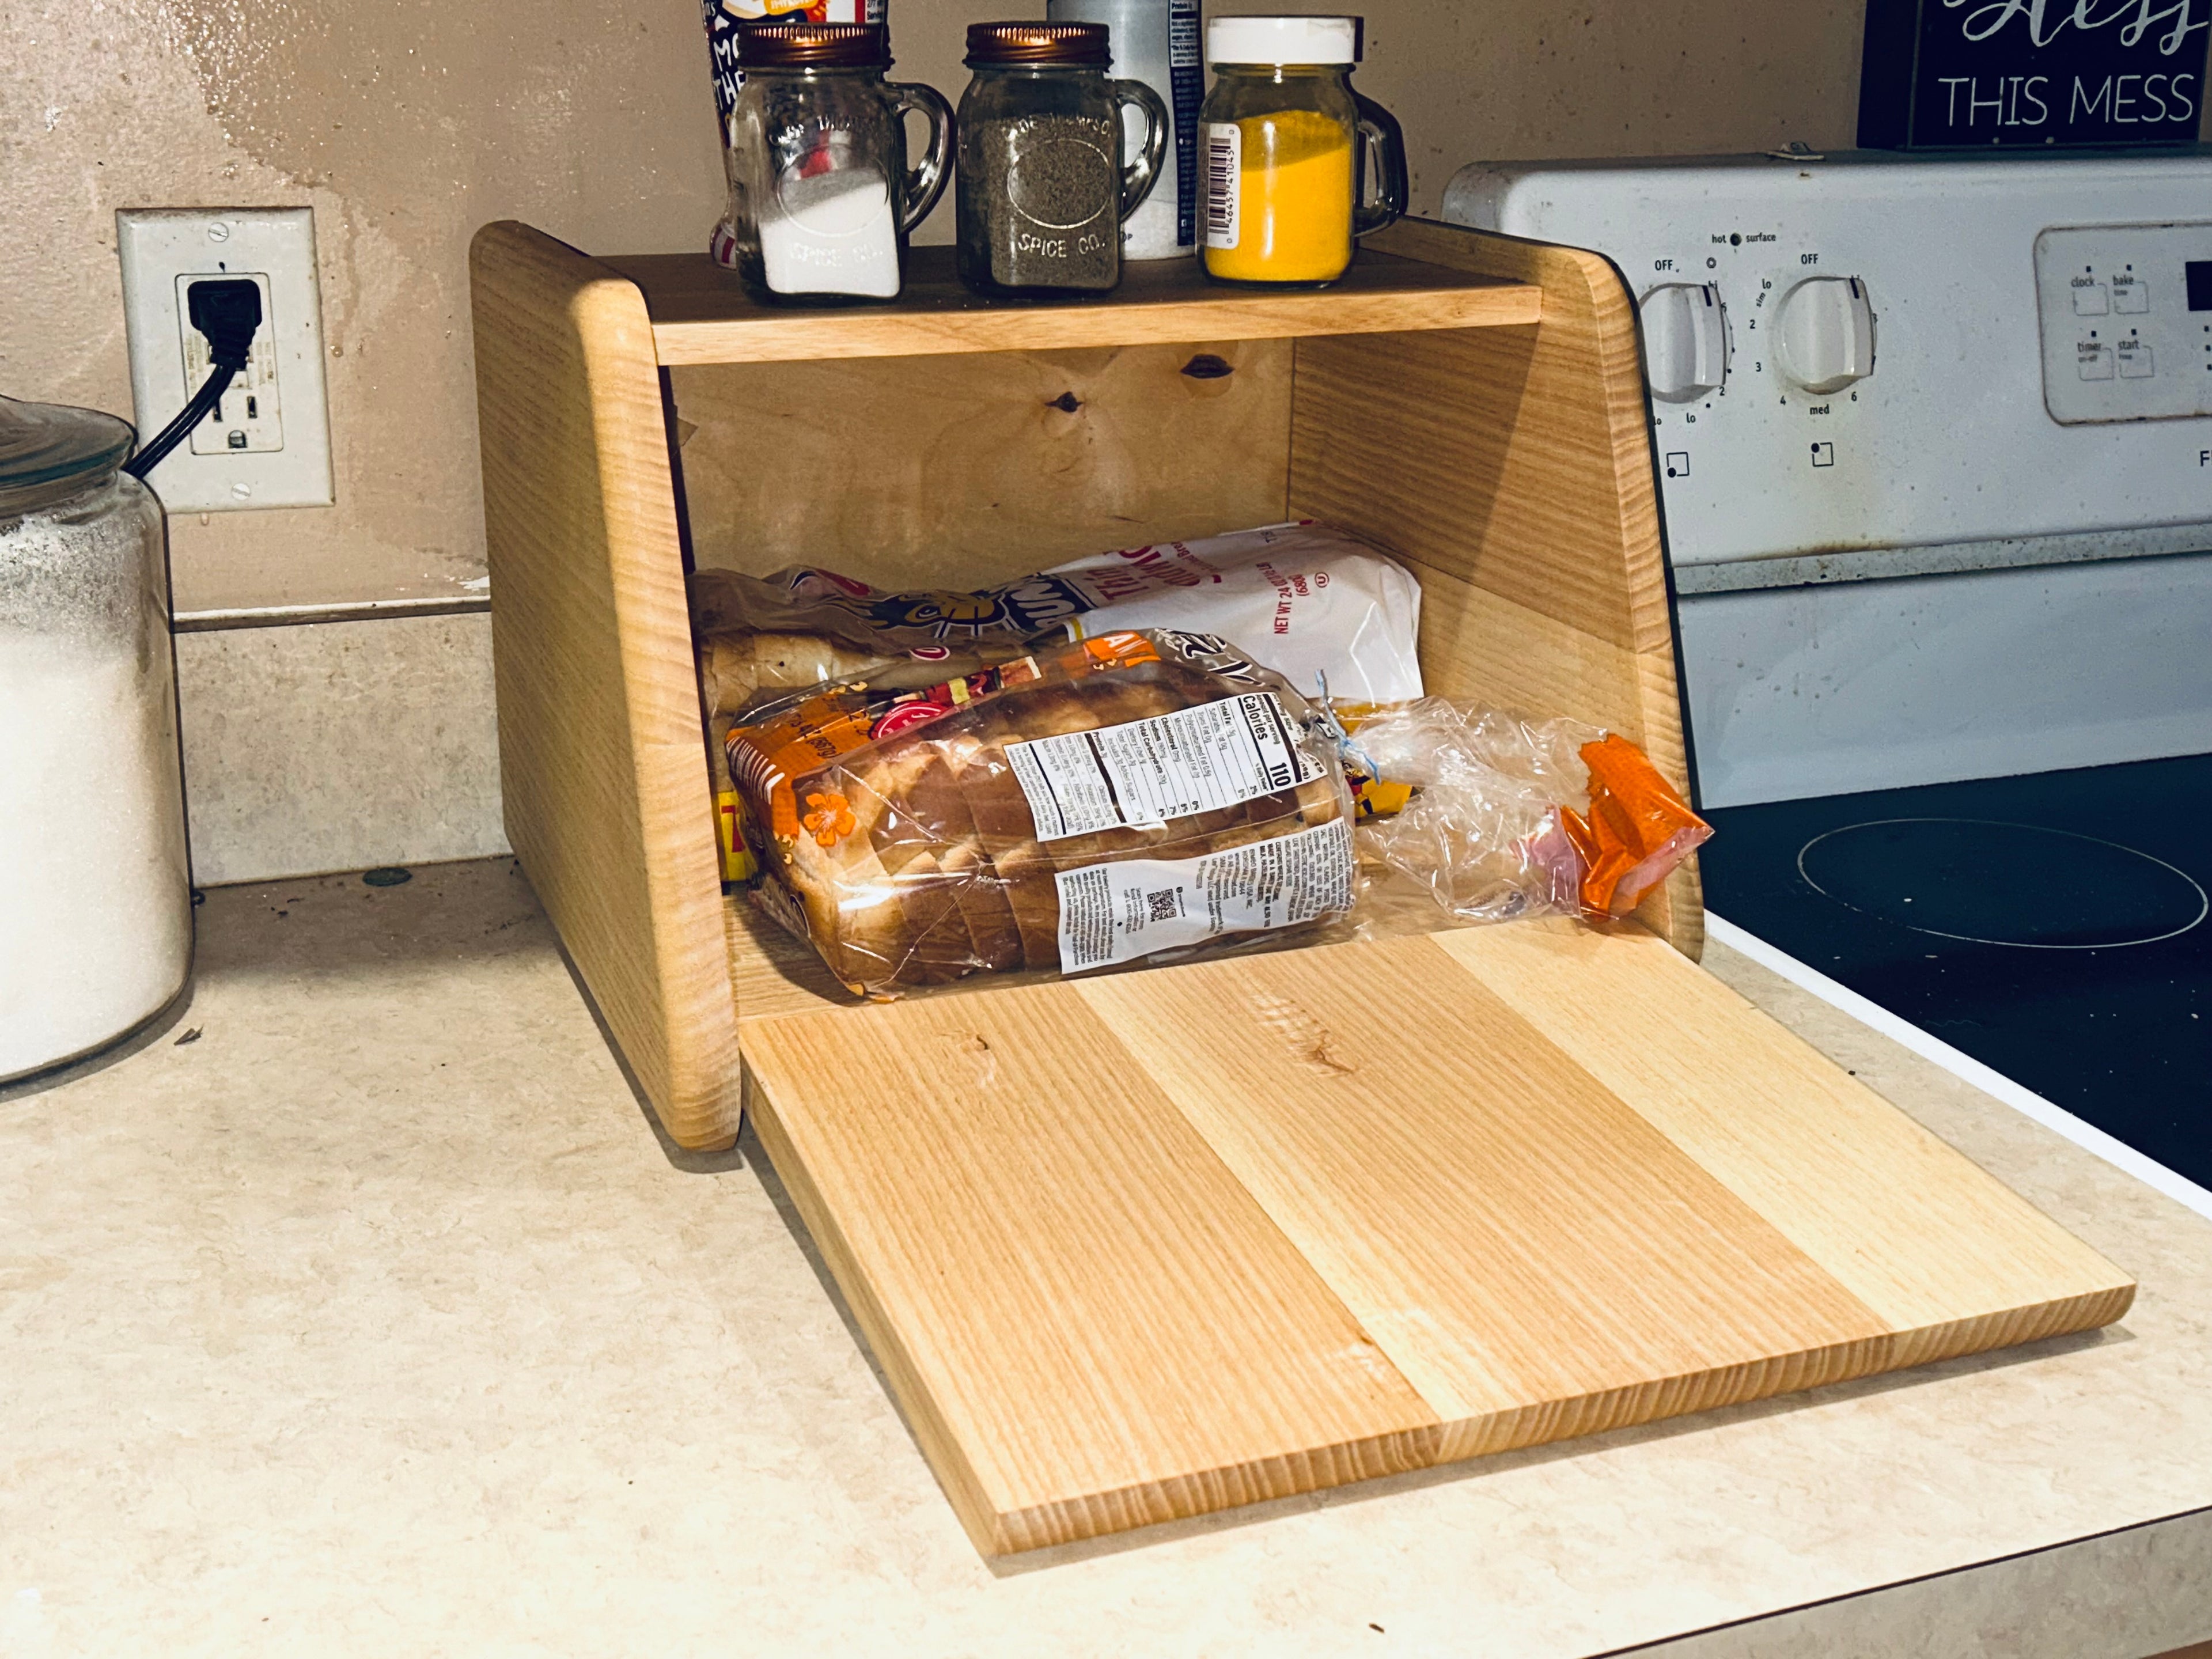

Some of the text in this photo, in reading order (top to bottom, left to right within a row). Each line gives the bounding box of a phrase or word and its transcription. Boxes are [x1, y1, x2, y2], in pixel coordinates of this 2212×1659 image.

[1938, 74, 2194, 126] THIS MESS
[1712, 233, 1776, 244] hot surface
[1018, 233, 1067, 258] SPICE
[1801, 254, 1819, 264] OFF
[1655, 260, 1673, 271] OFF
[1762, 279, 1771, 289] lo
[2071, 275, 2134, 287] clock bake
[1749, 320, 1756, 329] 2
[2078, 340, 2139, 353] timer start
[1756, 362, 1762, 372] 3
[1719, 387, 1725, 396] 2
[1851, 392, 1857, 402] 6
[1810, 404, 1830, 415] med
[1277, 586, 1293, 599] 24
[1276, 600, 1291, 615] WT
[1273, 616, 1290, 635] NET
[1218, 702, 1230, 717] Total
[1137, 722, 1149, 737] Total
[1240, 694, 1295, 787] Calories 110
